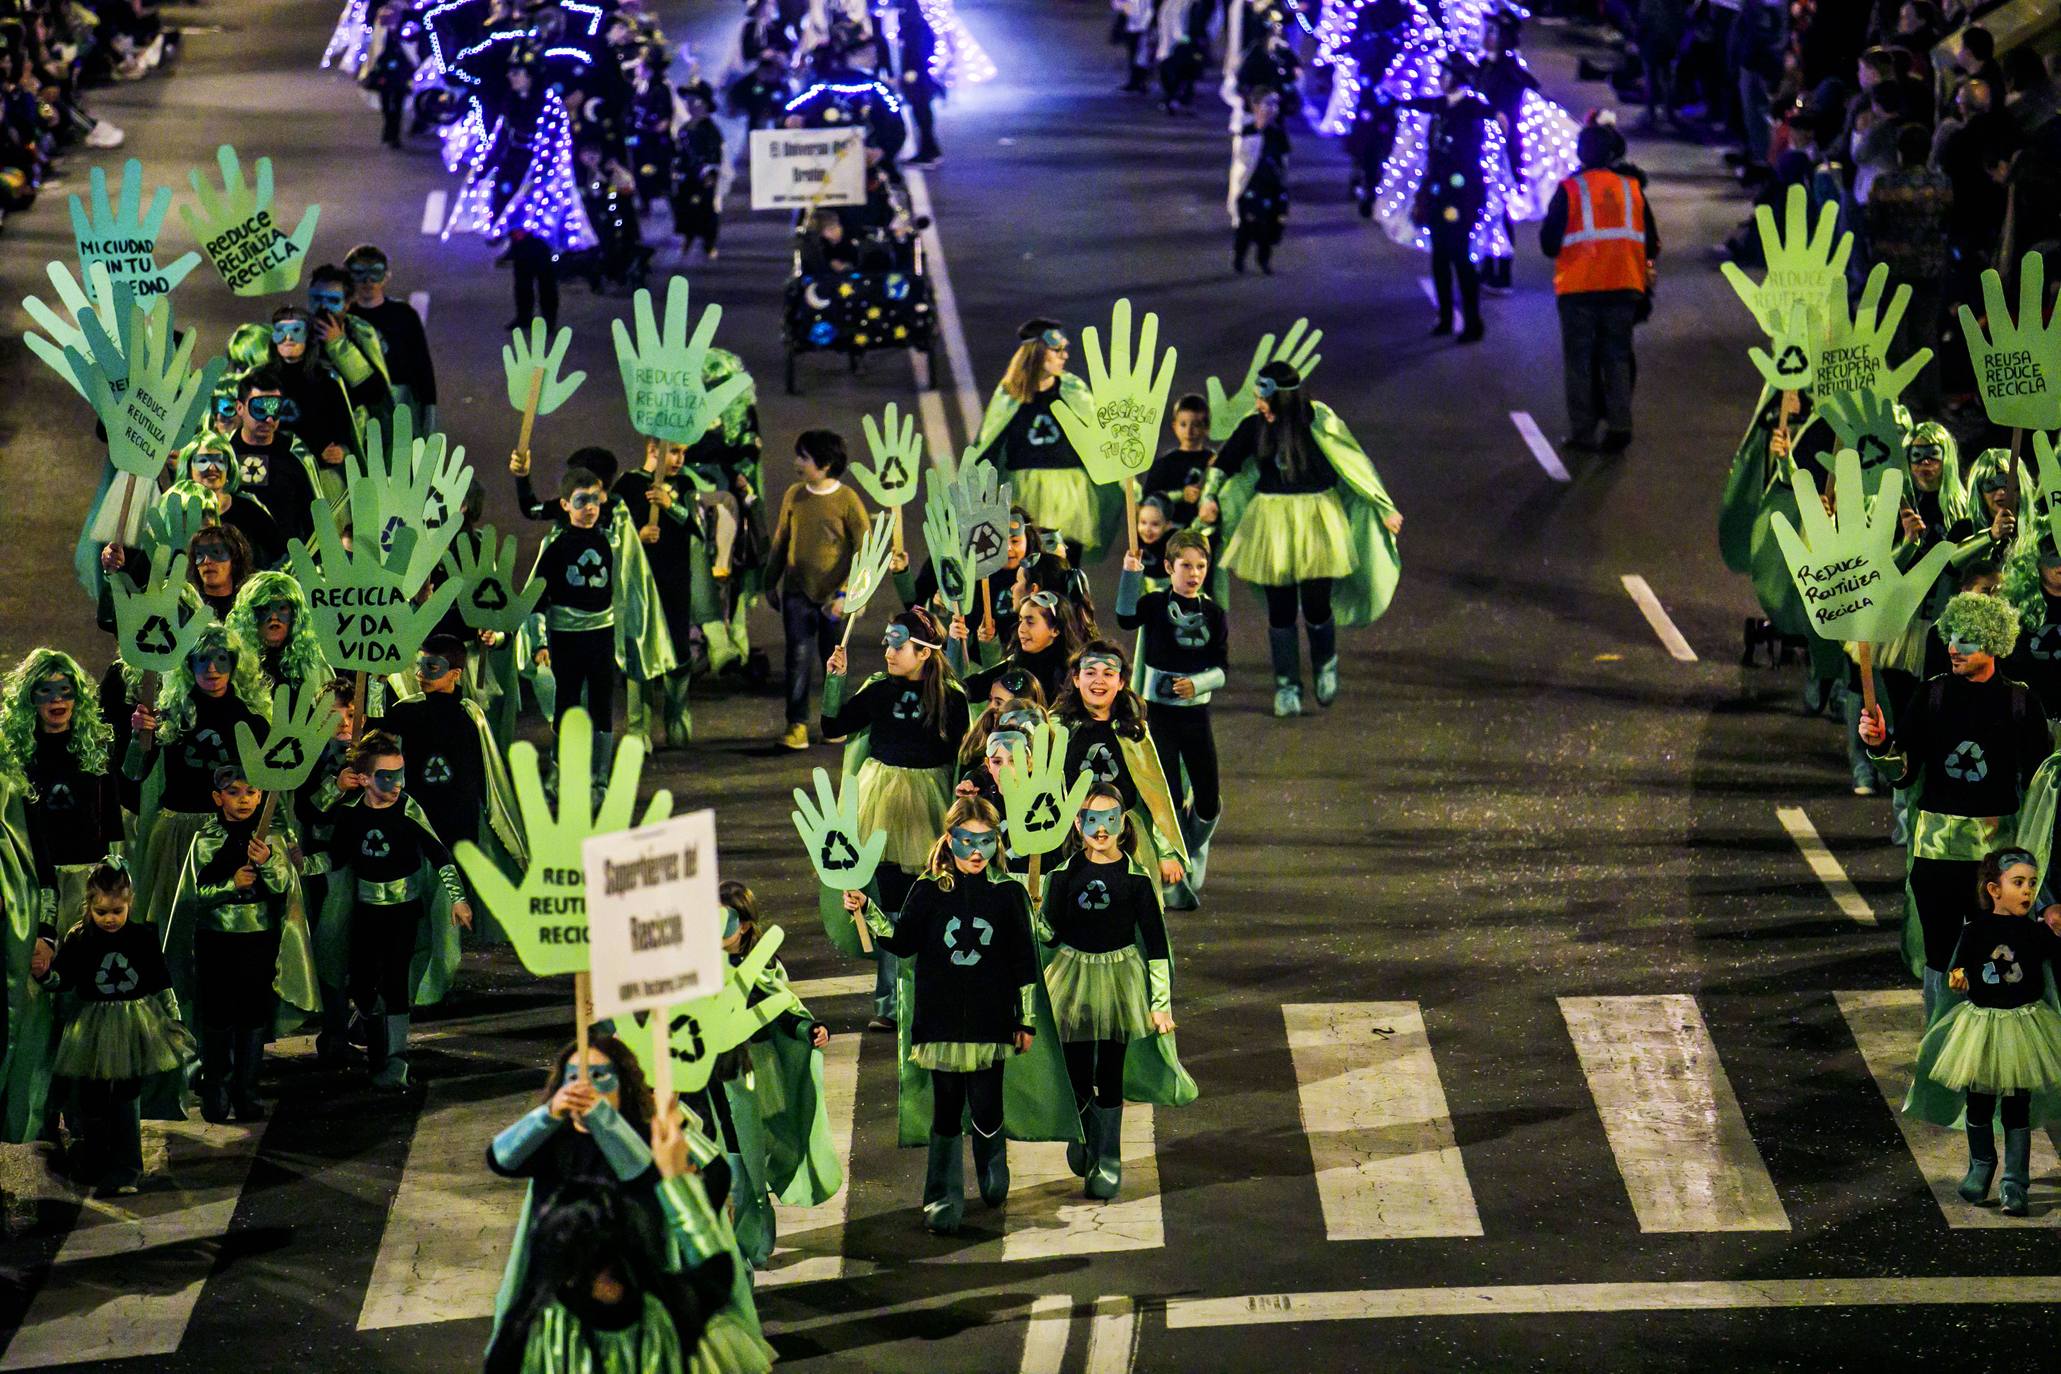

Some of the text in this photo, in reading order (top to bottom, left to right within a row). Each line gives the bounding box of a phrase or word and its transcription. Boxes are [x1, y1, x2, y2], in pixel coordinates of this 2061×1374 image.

[103, 239, 154, 254] CIUDAD
[93, 257, 151, 274] IN TU
[1822, 344, 1871, 365] REDUCE
[1984, 350, 2031, 369] REUSA
[636, 367, 690, 387] REDUCE
[1817, 357, 1880, 381] RECUPERA
[1986, 363, 2042, 382] REDUCE
[1987, 376, 2047, 398] RECICLA
[136, 388, 167, 421] REDUCE
[127, 404, 166, 444] REUTILIZA
[125, 426, 157, 461] RECICLA
[311, 587, 405, 608] RECICLA
[336, 612, 394, 637] Y DA
[338, 640, 401, 662] VIDA
[543, 867, 586, 887] RED
[529, 896, 586, 915] REUTI
